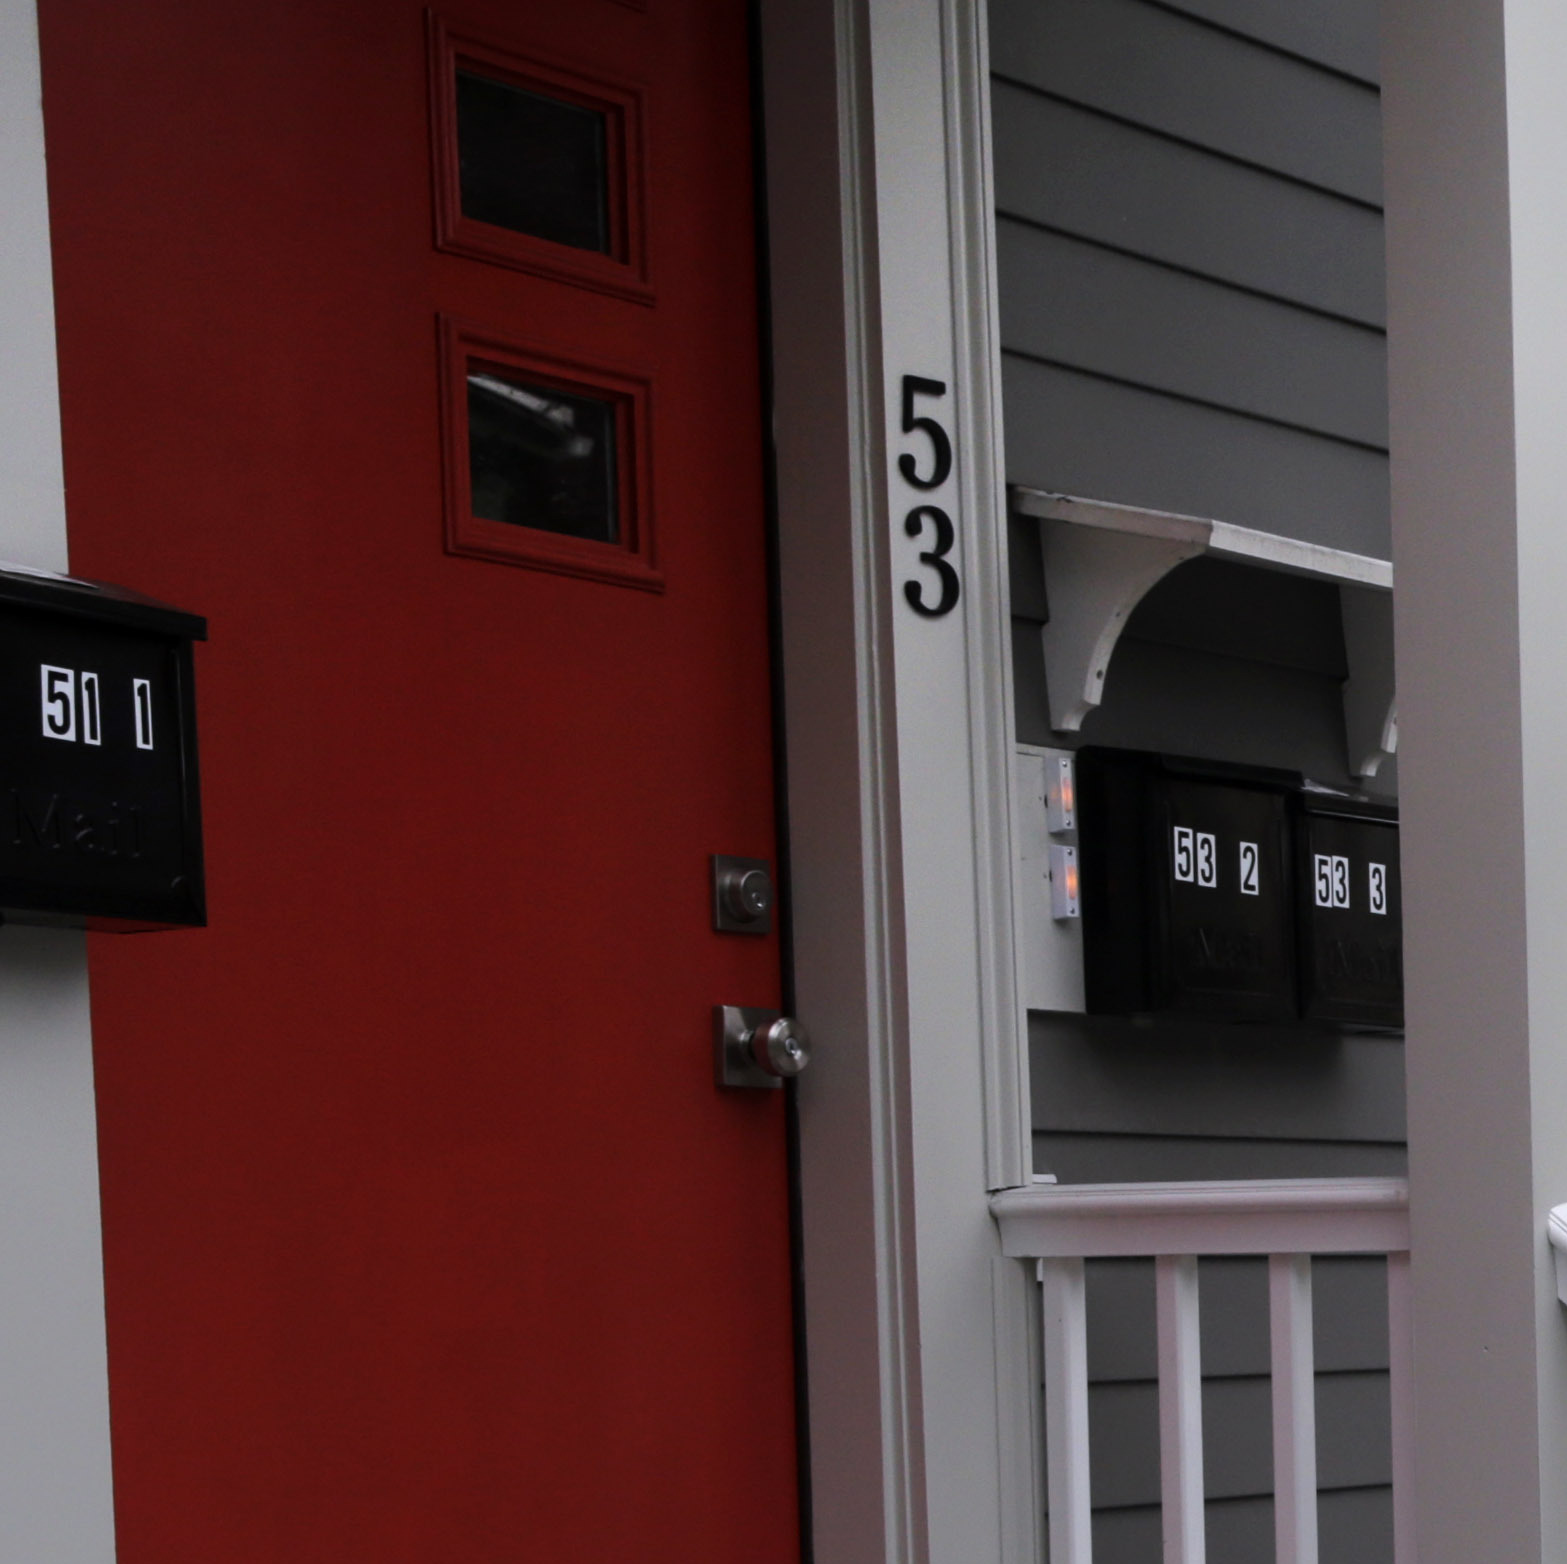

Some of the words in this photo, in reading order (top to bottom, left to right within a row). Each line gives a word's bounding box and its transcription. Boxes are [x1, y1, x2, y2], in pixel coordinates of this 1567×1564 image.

[898, 374, 960, 618] 53
[46, 669, 99, 742] 51
[136, 682, 151, 747] 1
[1177, 829, 1215, 885] 53
[1242, 844, 1257, 893] 2
[1318, 857, 1348, 906] 53
[1371, 866, 1385, 912] 3
